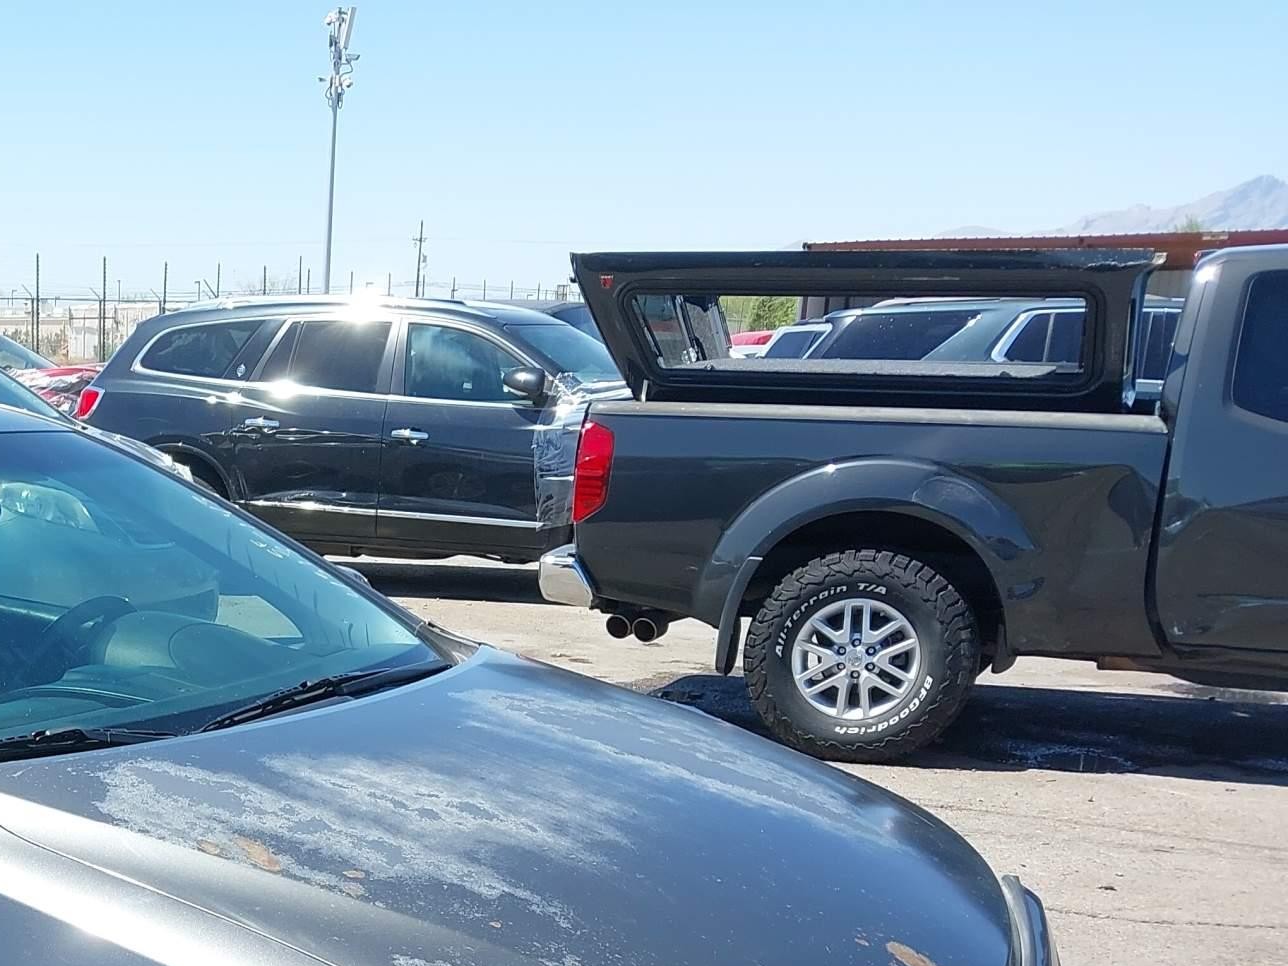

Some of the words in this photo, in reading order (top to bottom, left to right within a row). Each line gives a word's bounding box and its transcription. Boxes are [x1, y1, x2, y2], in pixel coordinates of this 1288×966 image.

[775, 584, 848, 659] All-Terrain
[856, 582, 888, 596] T/A
[834, 673, 934, 736] BFGoodrich
